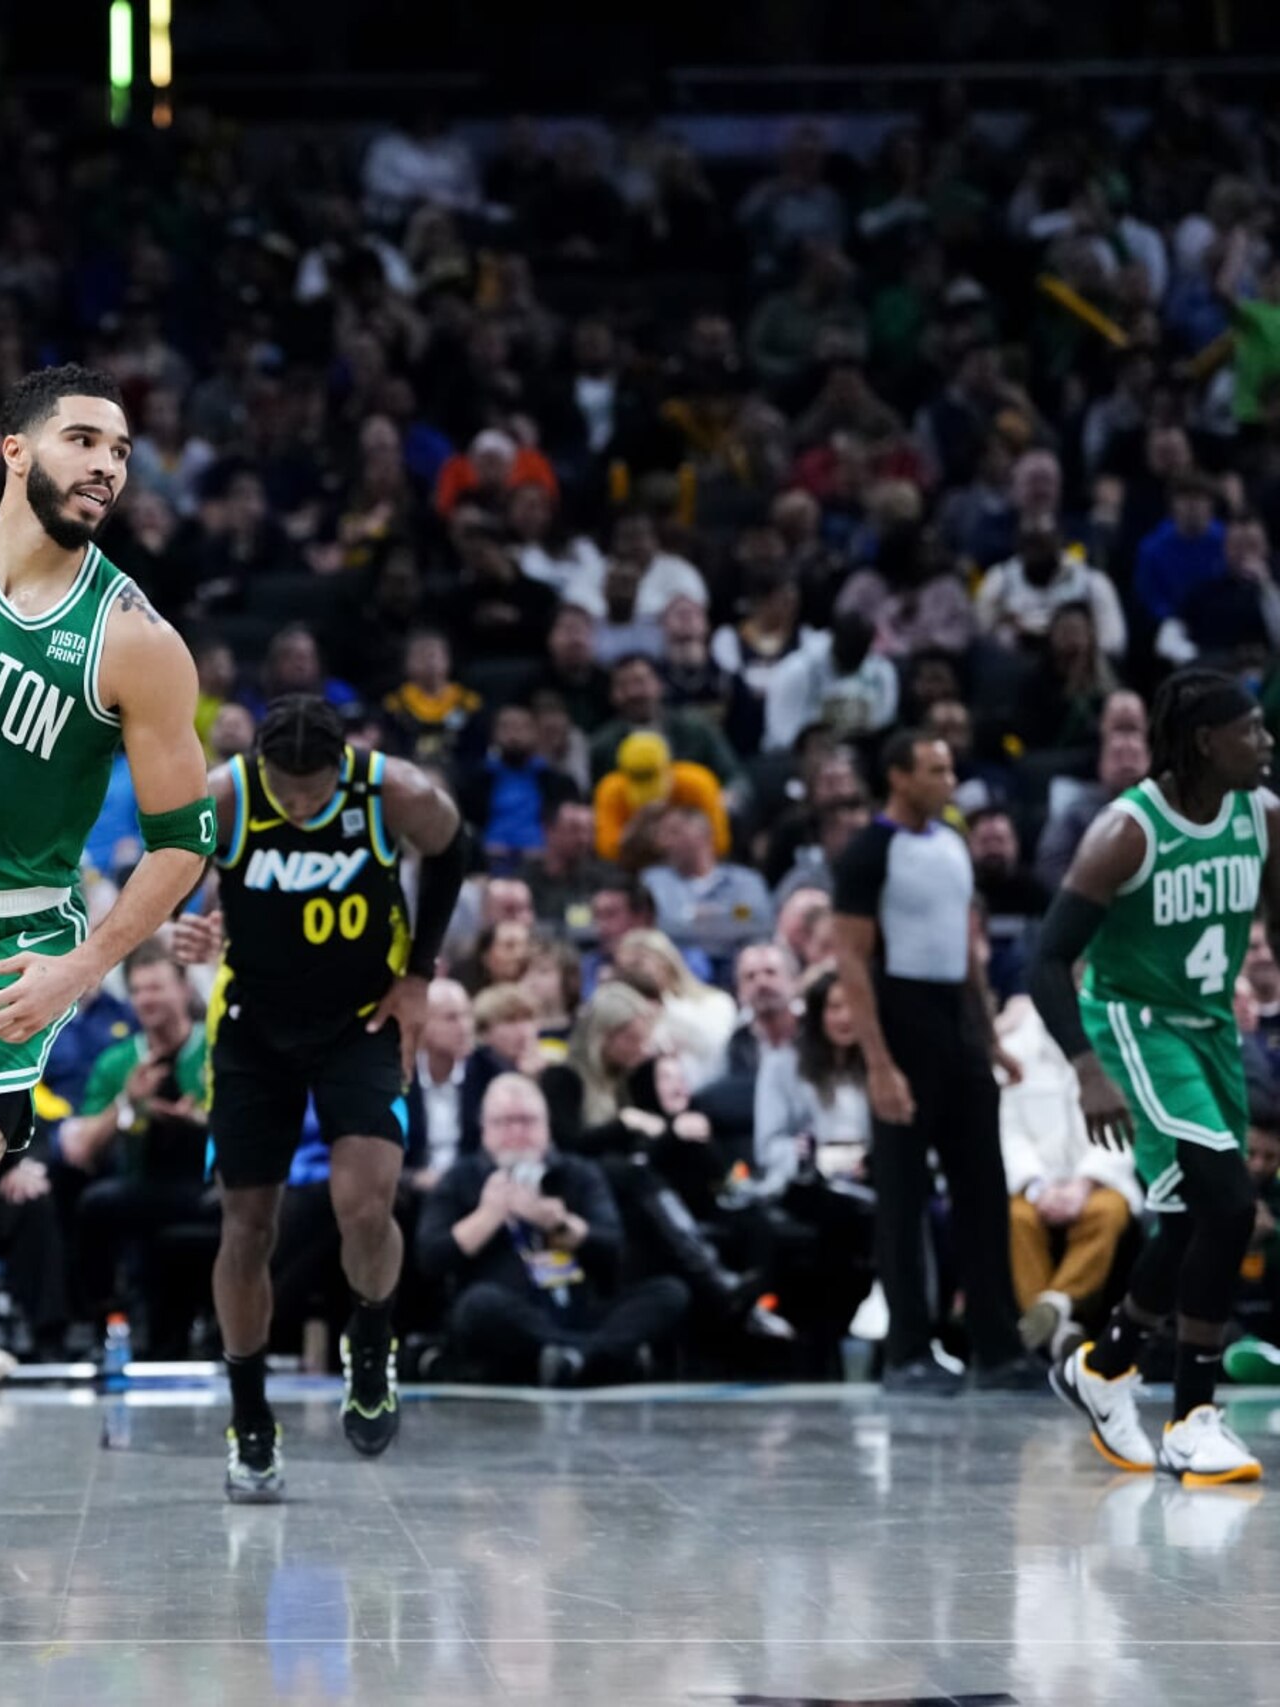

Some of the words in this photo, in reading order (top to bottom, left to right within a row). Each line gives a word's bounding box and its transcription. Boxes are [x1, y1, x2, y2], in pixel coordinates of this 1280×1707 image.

[46, 645, 85, 665] PRINT
[51, 629, 87, 652] VISTA
[244, 848, 370, 891] INDY
[1153, 855, 1261, 926] BOSTON
[303, 893, 368, 944] 00
[1185, 923, 1229, 996] 4
